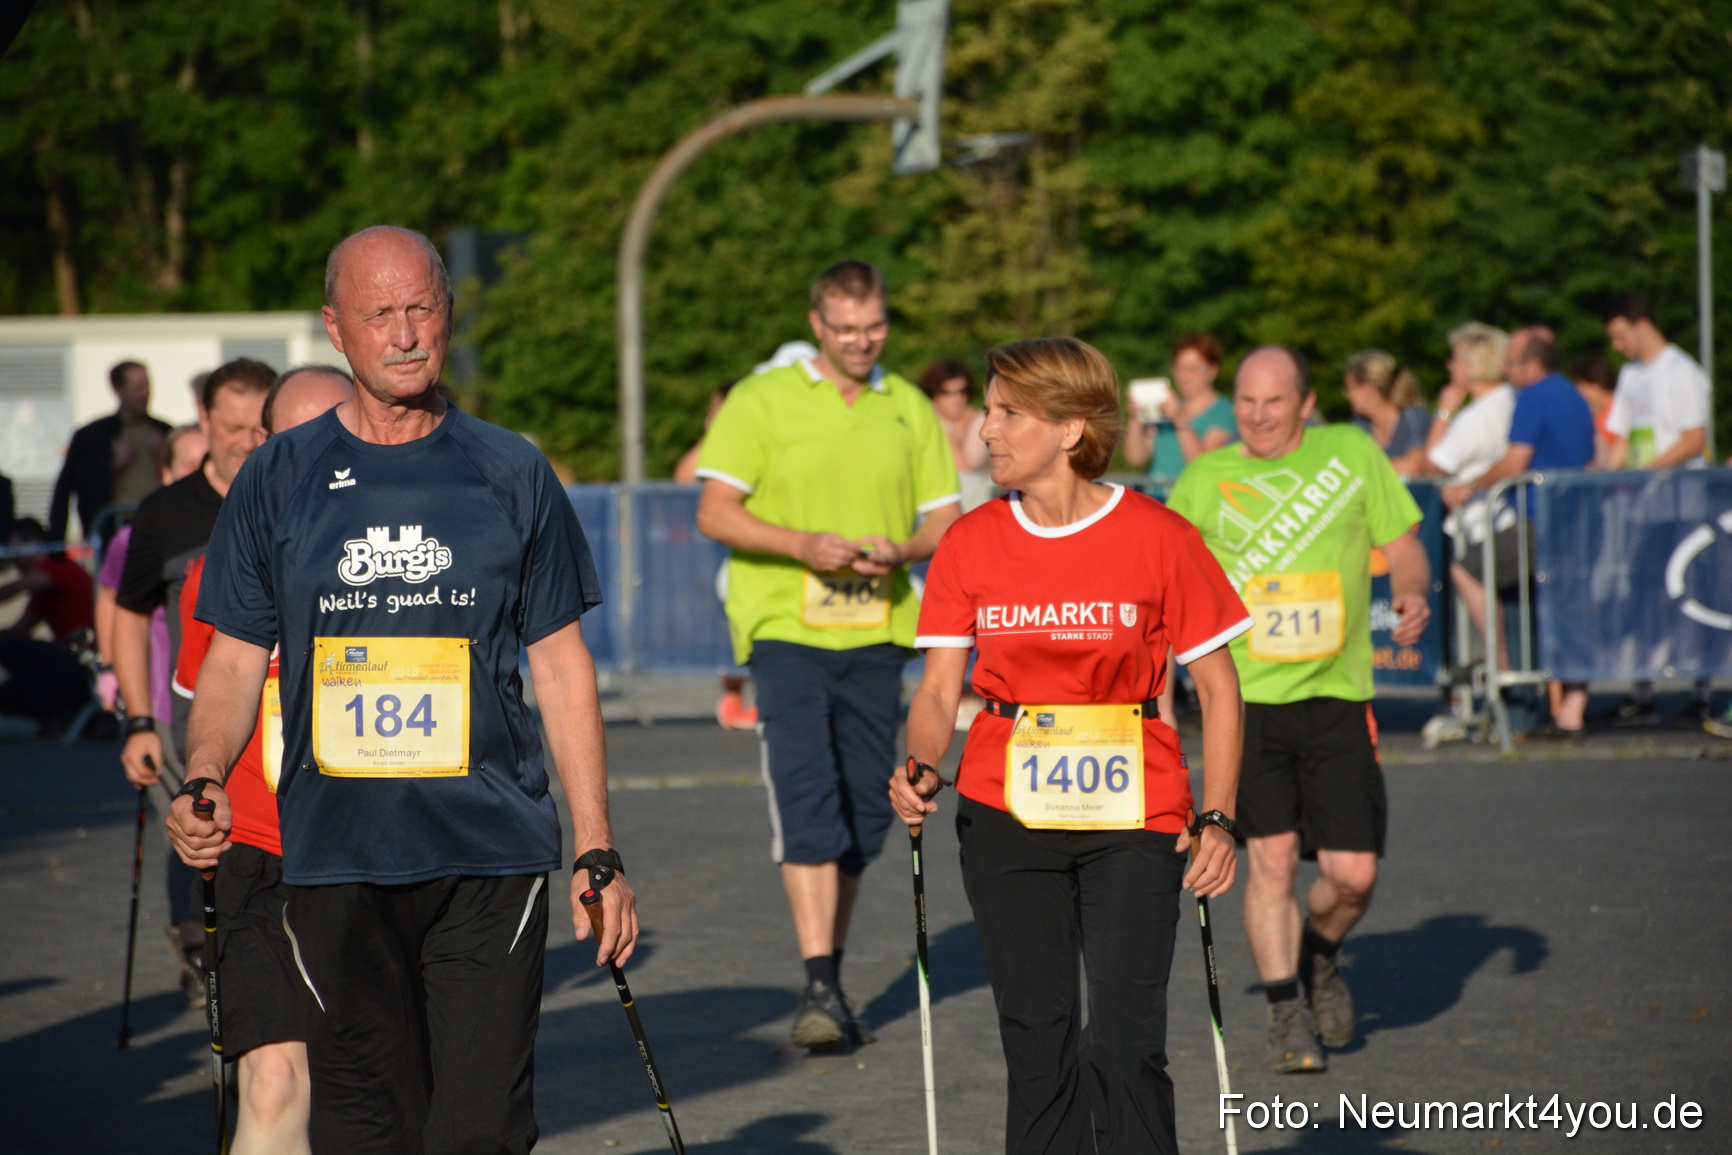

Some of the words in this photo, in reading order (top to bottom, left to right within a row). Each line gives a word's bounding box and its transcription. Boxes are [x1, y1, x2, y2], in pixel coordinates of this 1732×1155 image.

[329, 478, 356, 490] erima
[338, 538, 452, 586] Burgis
[319, 591, 378, 613] Weil's
[386, 586, 442, 613] guad
[451, 588, 476, 607] is!
[977, 602, 1114, 629] NEUMARKT
[1266, 608, 1321, 637] 211
[1051, 633, 1084, 641] STARKE
[335, 661, 389, 671] firmenlauf
[321, 676, 362, 687] walken
[345, 693, 437, 738] 184
[358, 749, 377, 758] Paul
[379, 748, 421, 759] Dietmayr
[1022, 755, 1130, 794] 1406
[1044, 803, 1080, 812] Susanne
[1081, 803, 1104, 811] Meier
[645, 1064, 662, 1098] NORDIC
